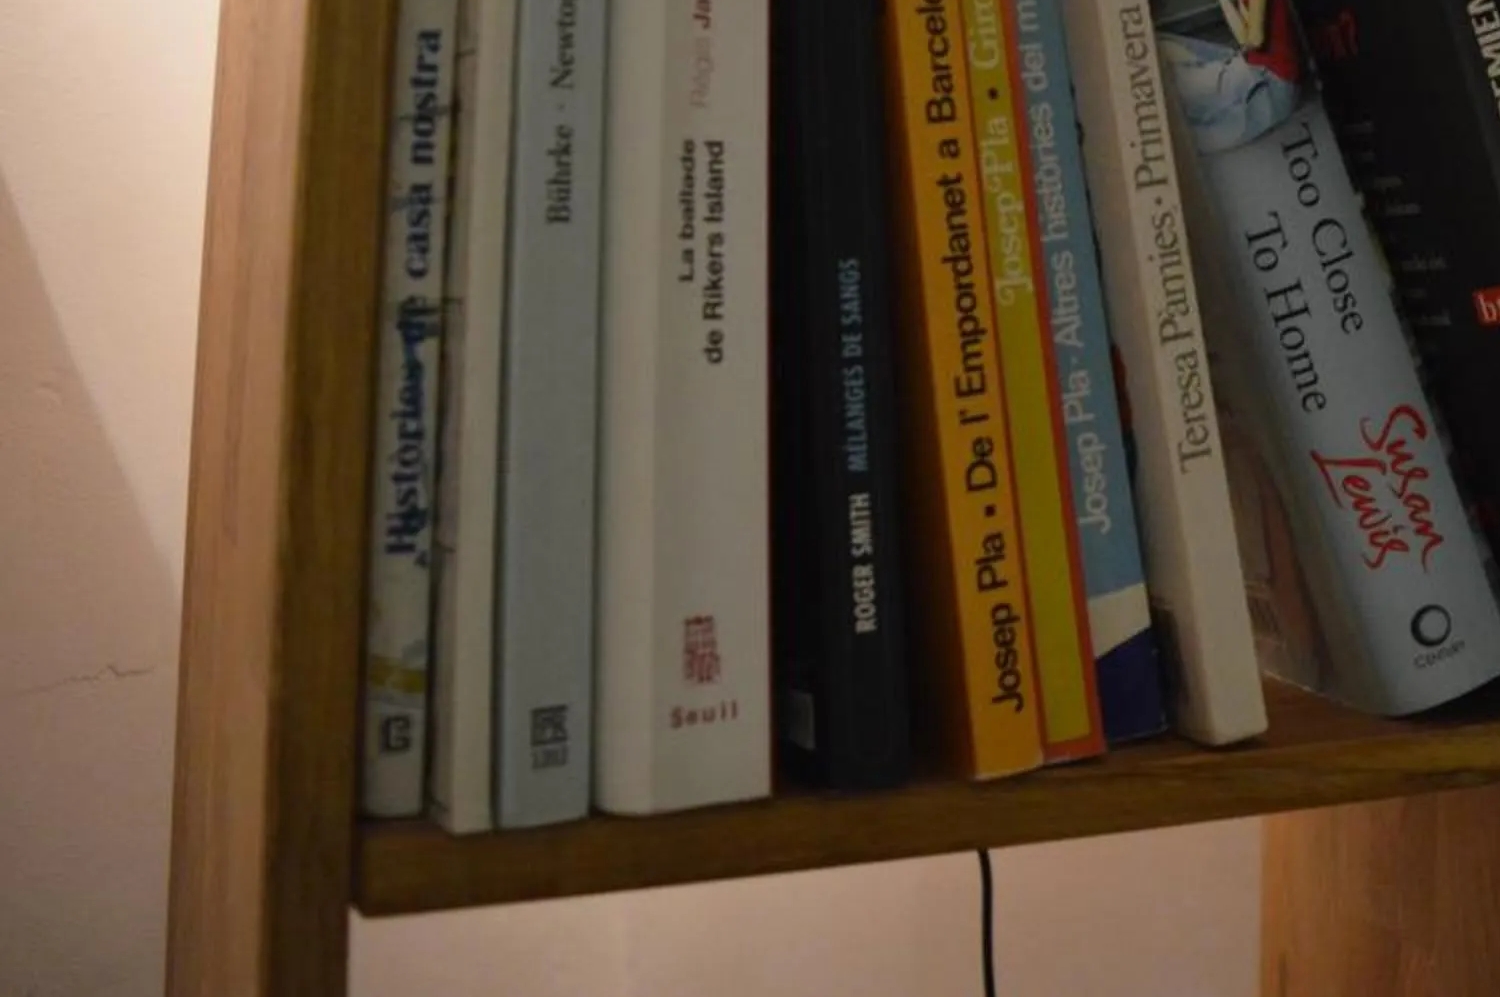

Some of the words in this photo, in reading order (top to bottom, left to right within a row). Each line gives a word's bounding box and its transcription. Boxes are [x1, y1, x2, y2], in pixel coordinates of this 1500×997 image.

[408, 28, 443, 167] nostra
[1018, 42, 1049, 92] del
[1117, 4, 1169, 193] Primavera
[546, 124, 577, 226] Bührke
[680, 139, 695, 241] ballade
[703, 139, 726, 230] Island
[938, 137, 960, 159] a
[980, 116, 1013, 194] Pla
[405, 183, 432, 278] casa
[679, 246, 694, 284] La
[995, 192, 1034, 307] Josep
[1282, 123, 1322, 210] Too
[1311, 217, 1365, 336] Close
[703, 236, 725, 334] Rikers
[838, 258, 861, 326] SANGS
[936, 172, 988, 399] Empordanet
[1051, 249, 1085, 349] Altres
[1246, 211, 1280, 273] To
[1266, 279, 1328, 414] Home
[704, 338, 724, 365] de
[841, 333, 863, 358] DE
[1062, 369, 1091, 424] Pla
[1174, 350, 1212, 475] Teresa
[965, 436, 998, 492] De
[1074, 431, 1109, 533] Josep
[1310, 450, 1409, 571] Lewis
[1360, 405, 1445, 573] Susan
[849, 493, 871, 557] SMITH
[974, 534, 1009, 593] Pla
[855, 563, 877, 634] ROGER
[991, 604, 1025, 713] Josep
